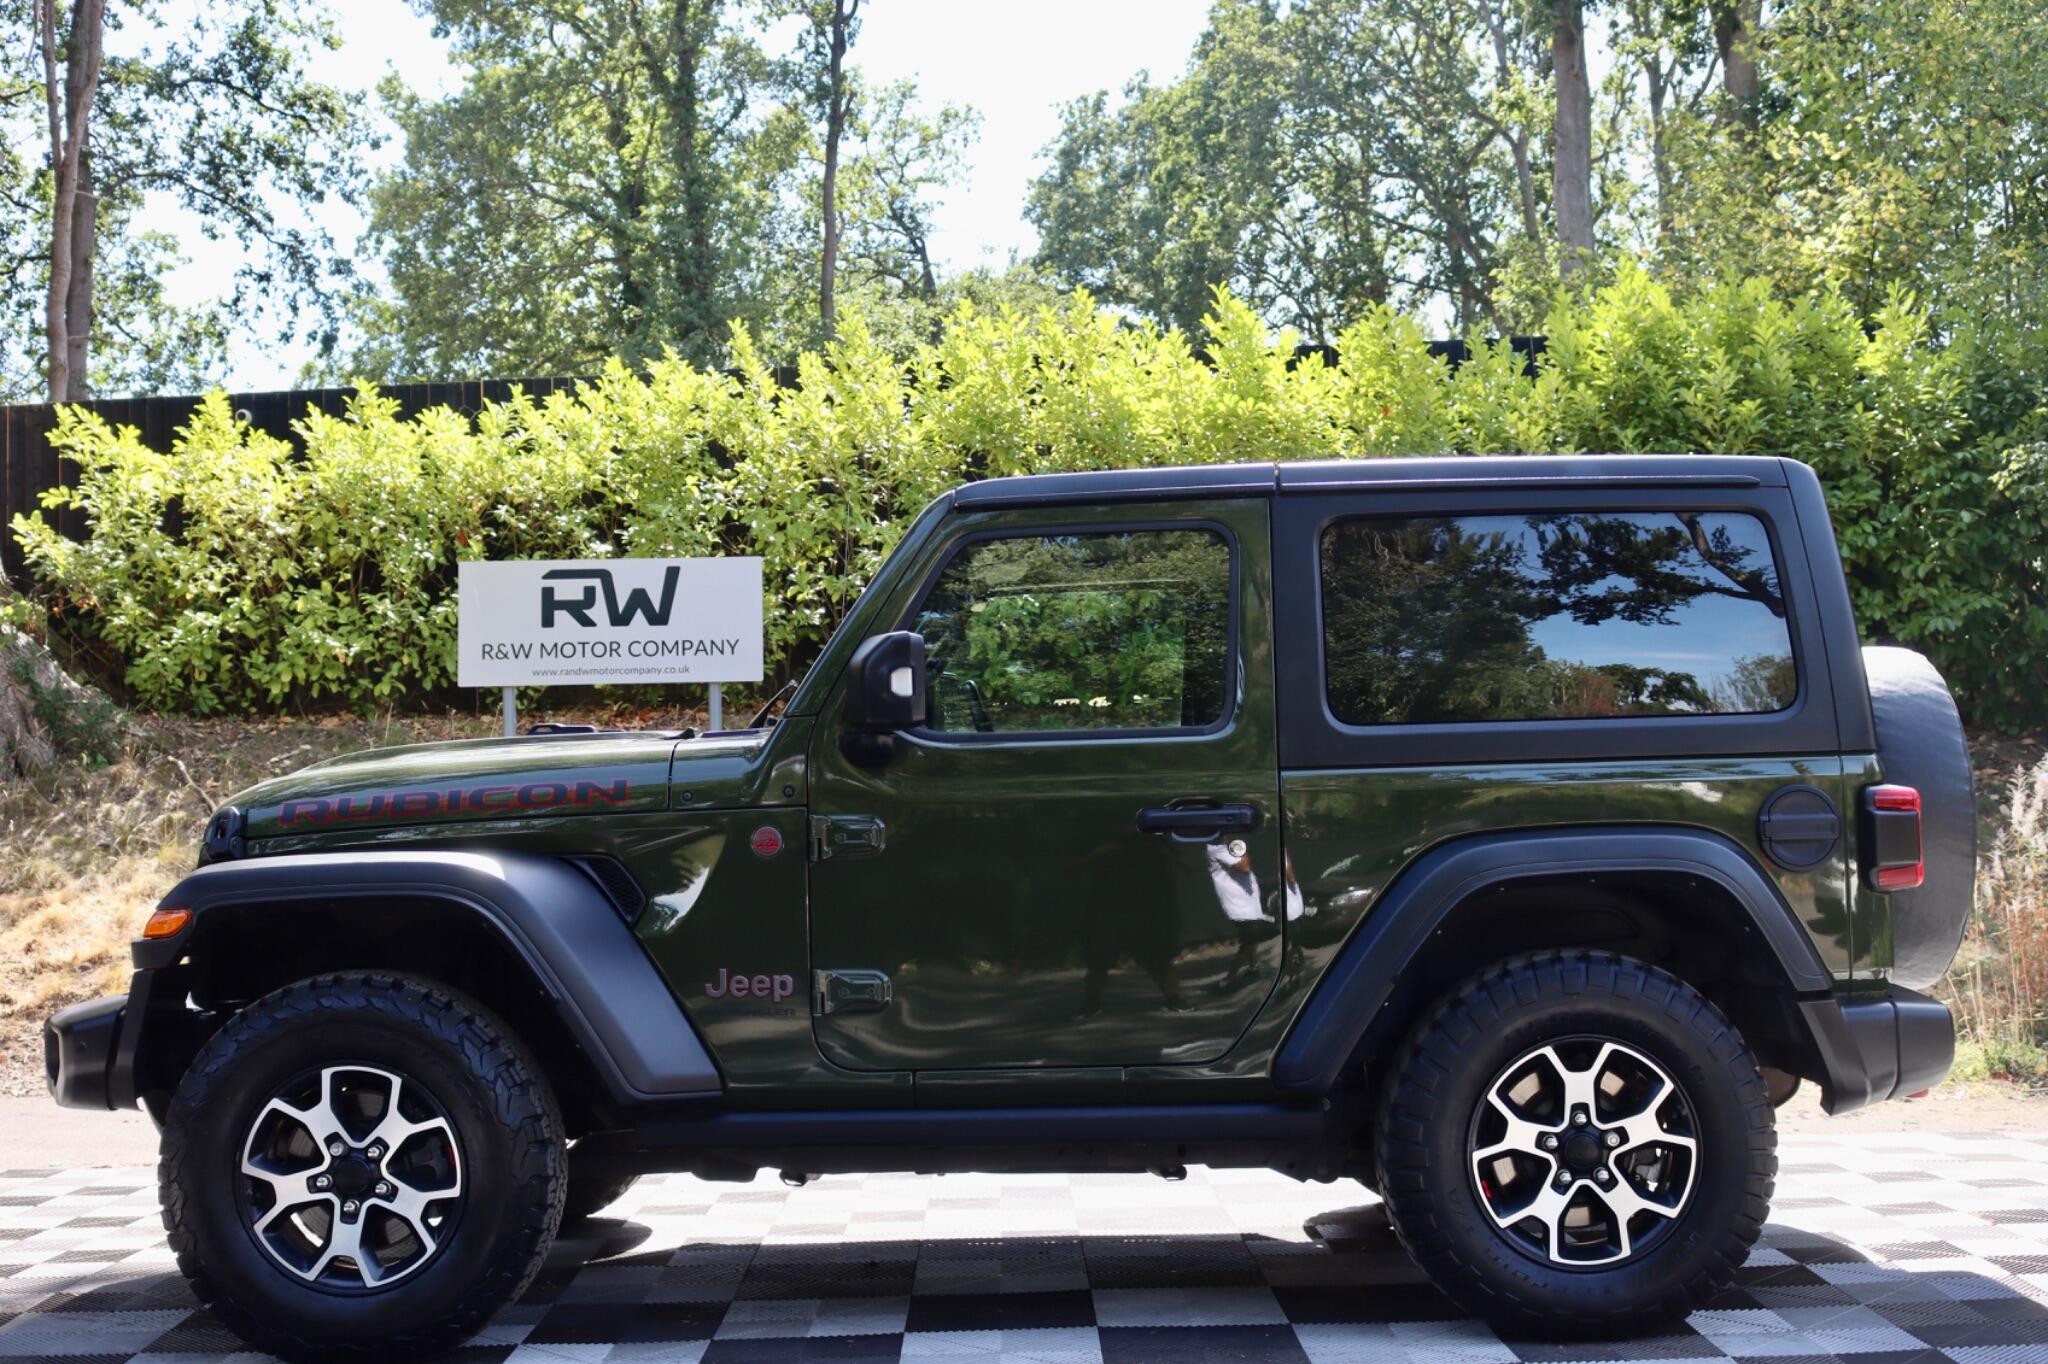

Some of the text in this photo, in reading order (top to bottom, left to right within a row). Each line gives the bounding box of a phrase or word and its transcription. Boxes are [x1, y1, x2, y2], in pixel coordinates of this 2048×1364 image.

[541, 566, 680, 628] RW
[481, 638, 740, 660] R&W MOTOR COMPANY
[531, 664, 690, 677] www.randwmotorcompany.co.uk
[279, 779, 630, 827] RUBICON
[704, 968, 794, 1002] Jeep
